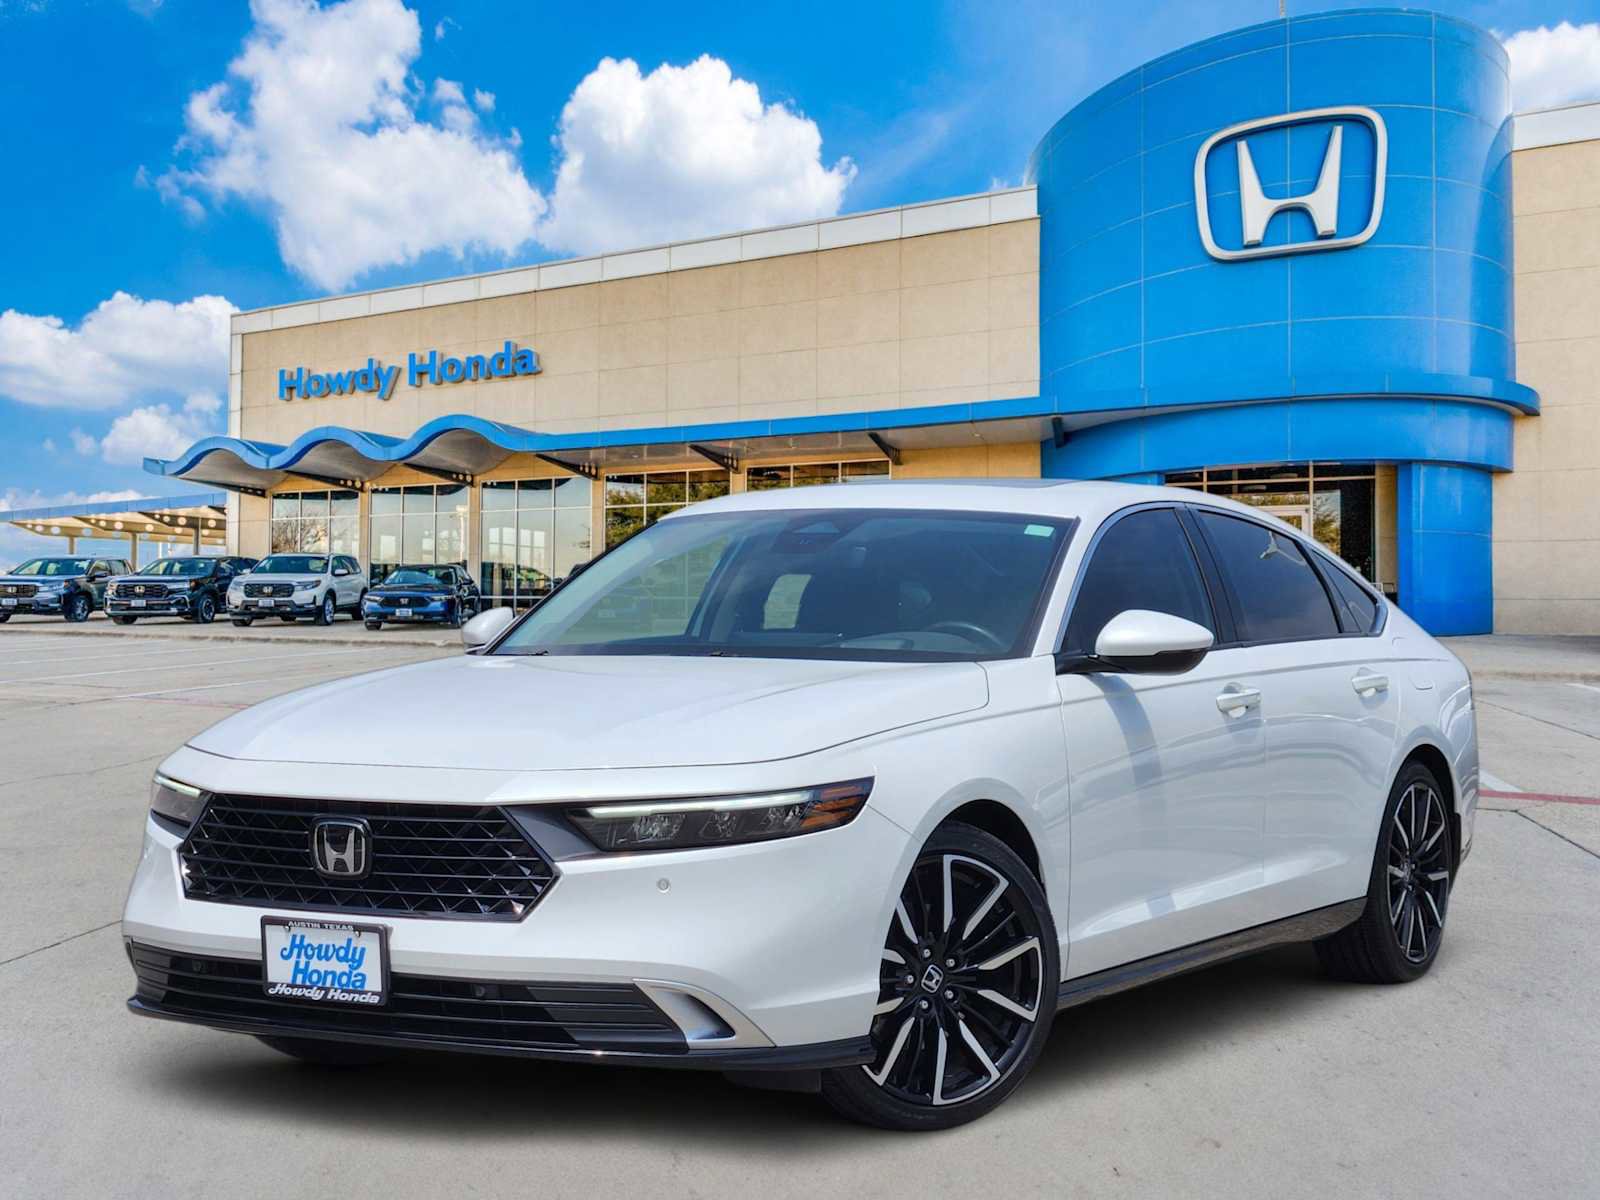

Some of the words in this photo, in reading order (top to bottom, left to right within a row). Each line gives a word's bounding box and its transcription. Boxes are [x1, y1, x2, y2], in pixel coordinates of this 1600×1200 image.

[278, 358, 401, 401] Howdy
[408, 340, 542, 387] Honda
[324, 923, 354, 931] TEXAS
[280, 934, 366, 970] Howdy
[291, 960, 366, 989] Honda
[268, 983, 326, 1000] Howdy
[327, 988, 380, 1003] Honda
